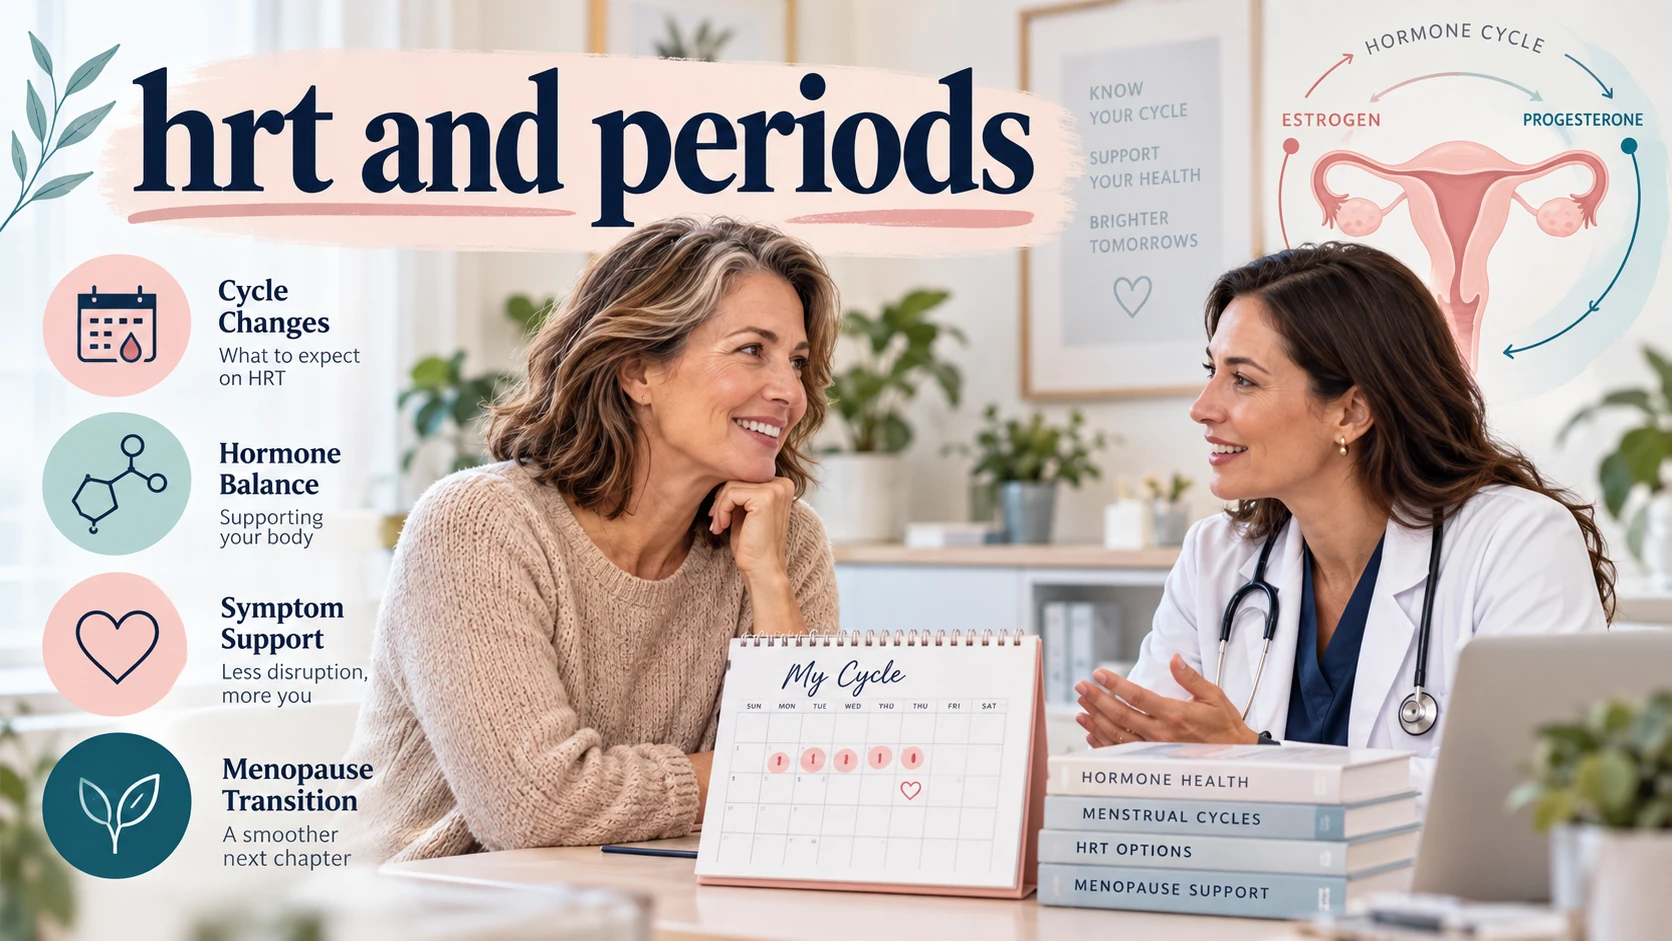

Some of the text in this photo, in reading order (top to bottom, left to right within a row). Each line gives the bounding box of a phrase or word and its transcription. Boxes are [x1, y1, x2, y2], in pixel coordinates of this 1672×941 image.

[1089, 81, 1144, 101] KNOW
[1089, 102, 1188, 126] YOUR CYCLE
[1089, 145, 1160, 166] SUPPORT
[1089, 167, 1202, 190] YOUR HEALTH
[1089, 210, 1169, 230] BRIGHTER
[1089, 233, 1199, 254] TOMORROWS
[781, 659, 907, 698] My Cycle
[746, 702, 762, 710] SUN
[778, 702, 796, 710] MON
[813, 702, 827, 710] TUE
[844, 702, 862, 710] WED
[947, 702, 961, 710] FRI
[981, 702, 997, 710] SAT
[1082, 771, 1249, 790] HORMONE HEALTH
[1082, 807, 1261, 827] MENSTRUAL CYCLES
[1076, 841, 1192, 859] HRT OPTIONS
[1074, 878, 1270, 901] MENOPAUSE SUPPORT
